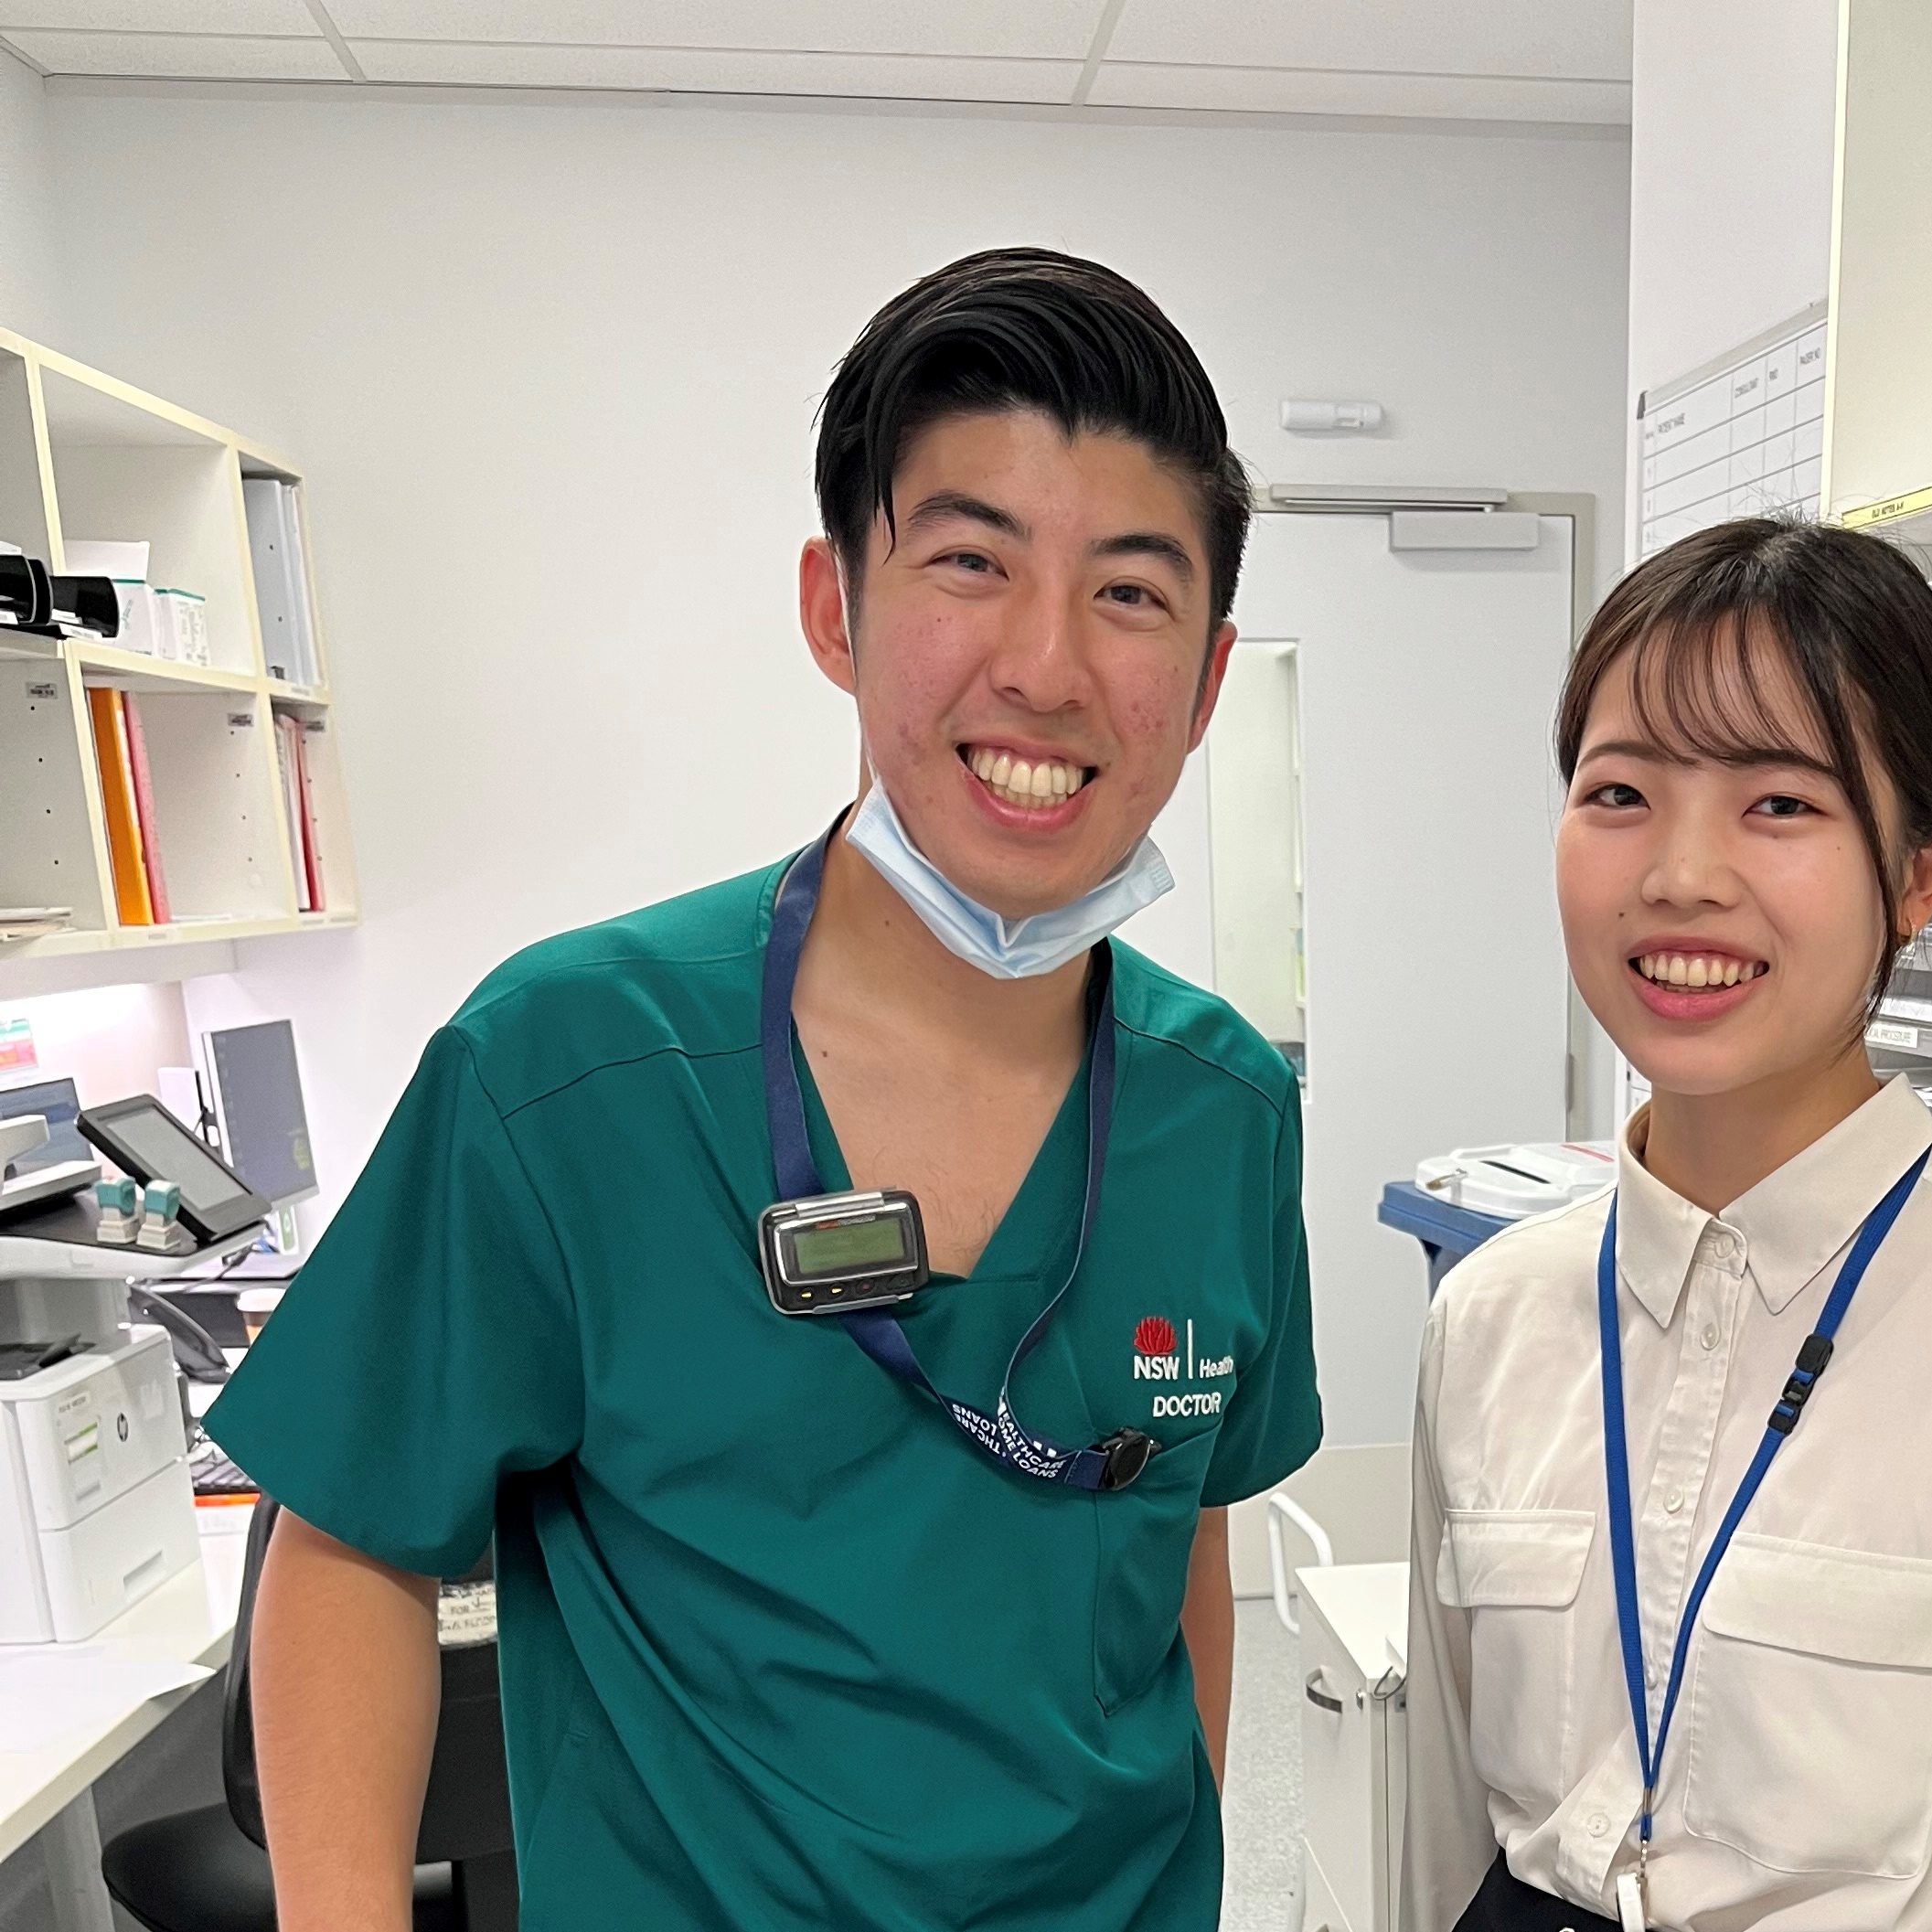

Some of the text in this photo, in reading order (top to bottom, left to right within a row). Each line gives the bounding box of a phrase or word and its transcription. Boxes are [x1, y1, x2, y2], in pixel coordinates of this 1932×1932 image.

[1134, 1355, 1233, 1380] NSW Health
[1153, 1392, 1222, 1417] DOCTOR
[1012, 1451, 1059, 1478] LOANS
